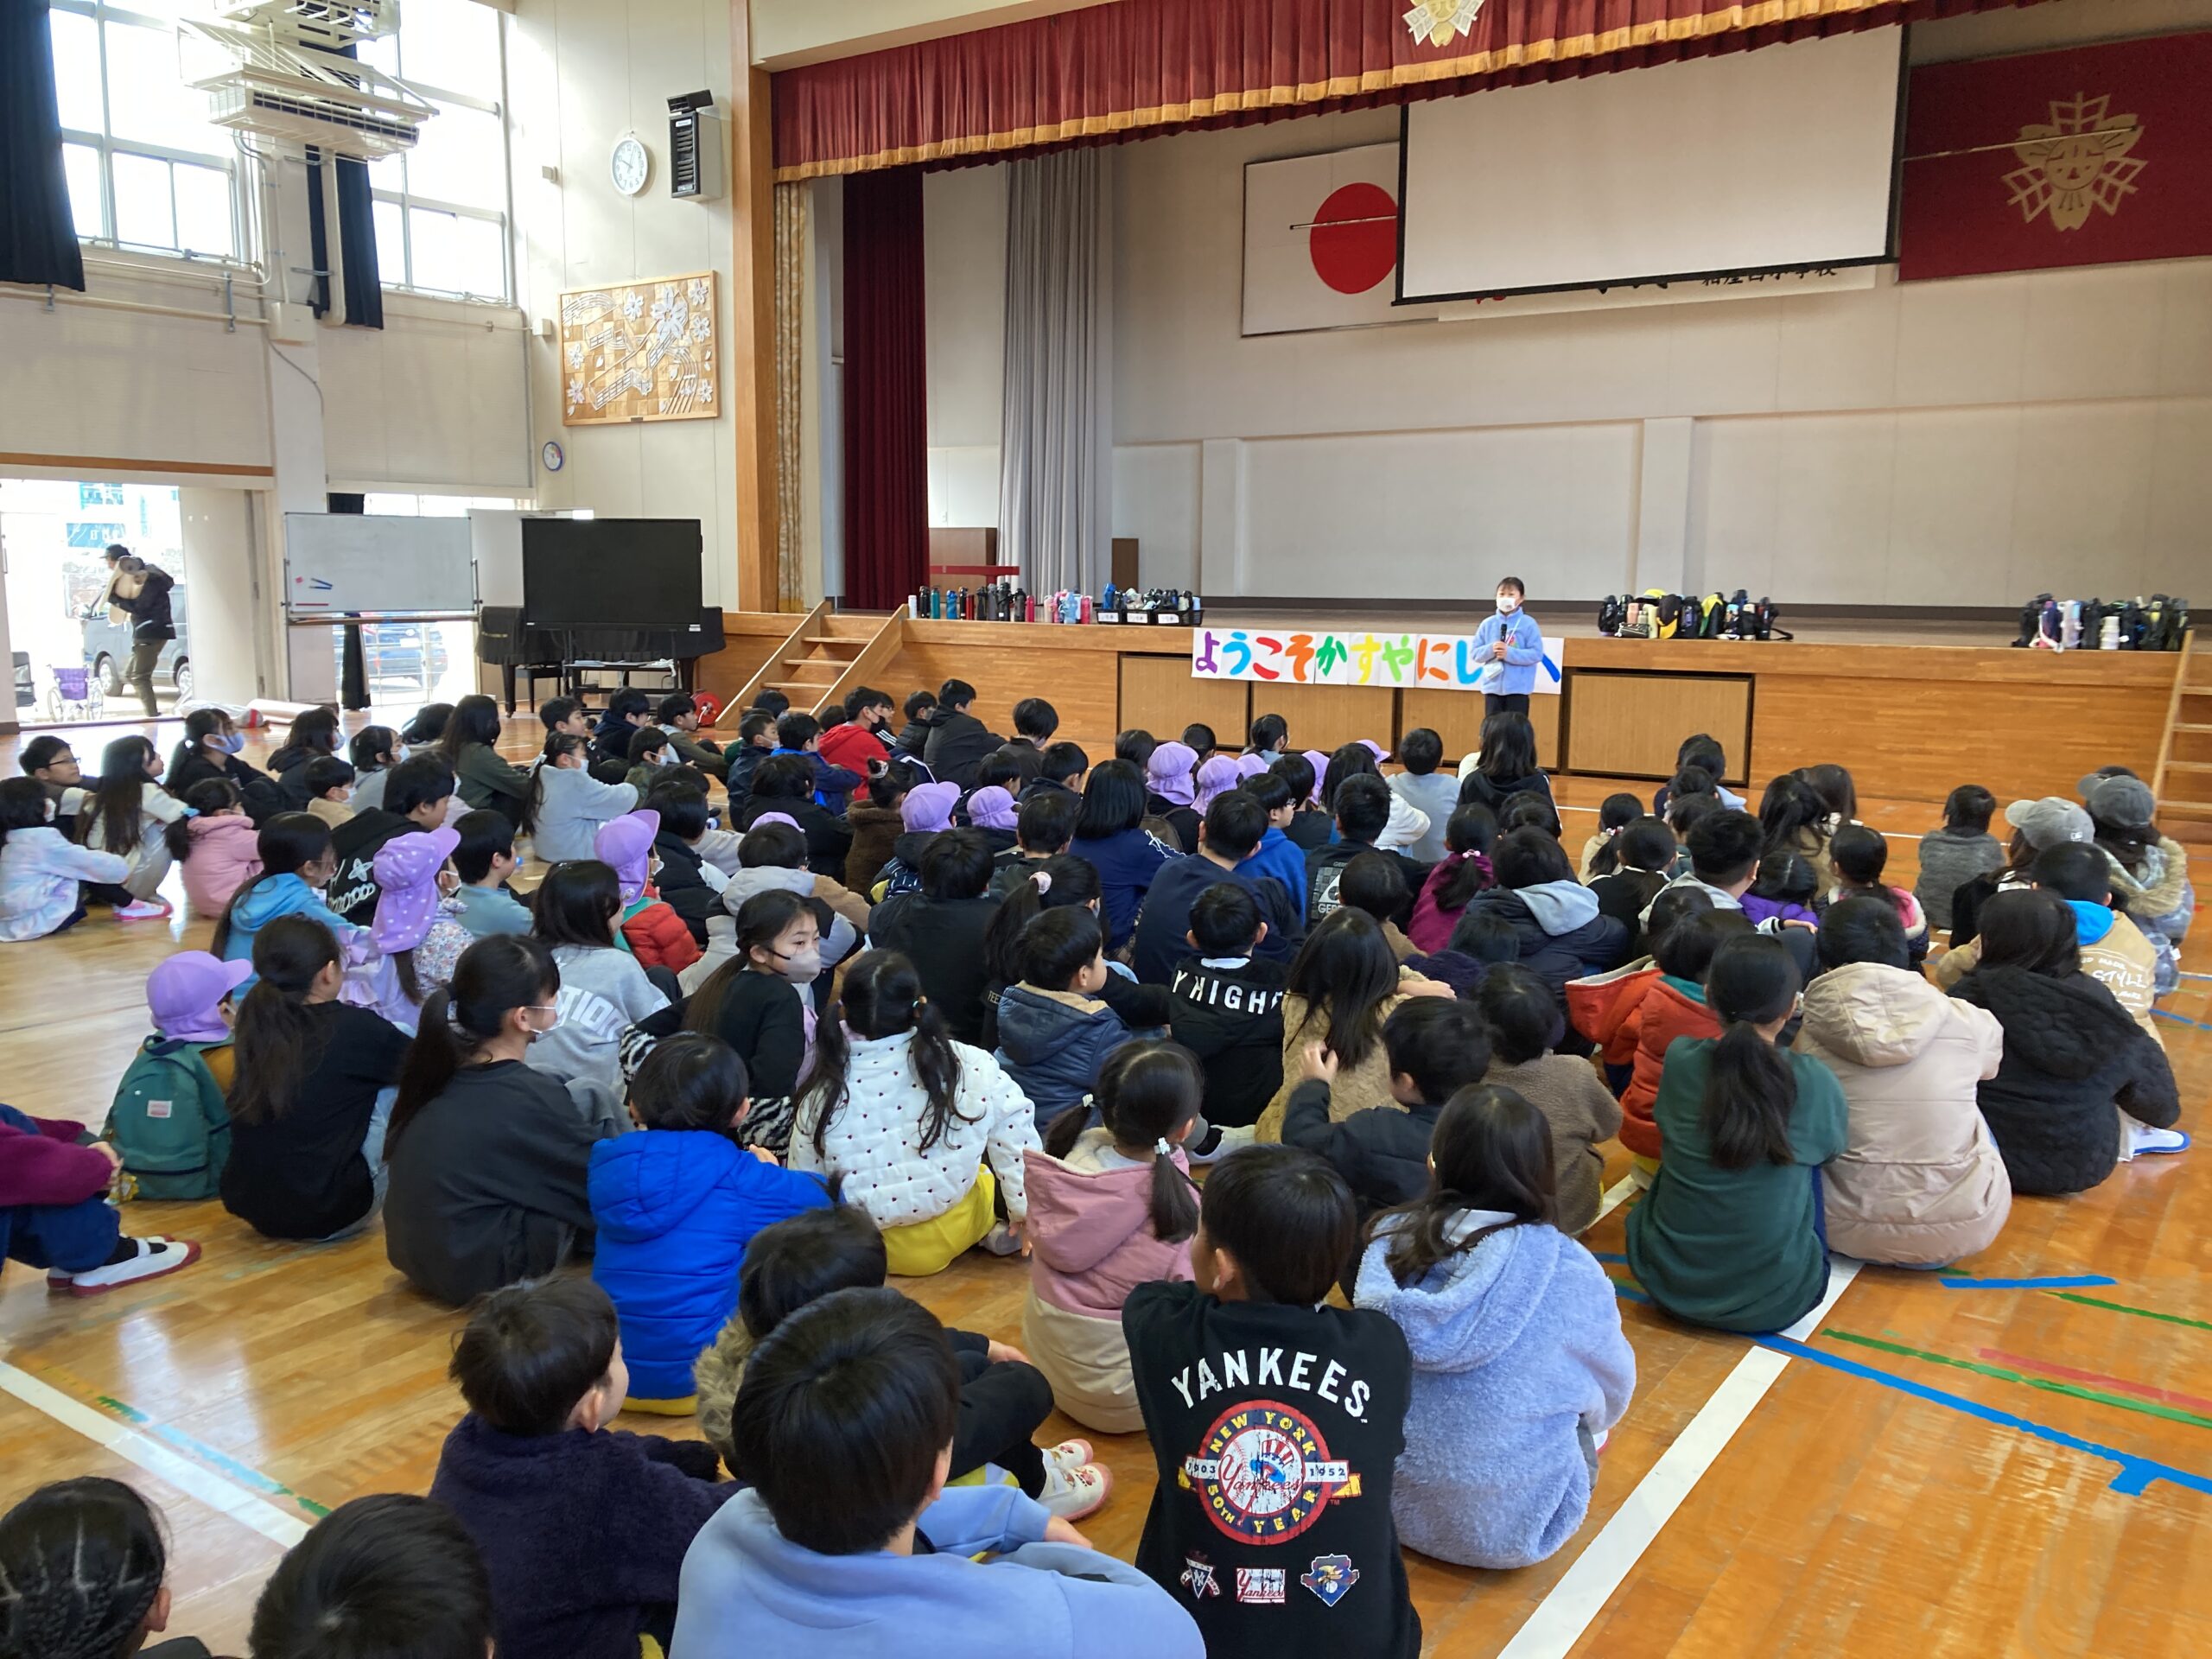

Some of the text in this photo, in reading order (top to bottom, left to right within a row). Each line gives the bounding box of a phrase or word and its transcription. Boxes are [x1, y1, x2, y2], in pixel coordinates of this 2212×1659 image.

[1195, 631, 1560, 683] ようこそかすやにしへ
[1172, 1347, 1370, 1417] YANKEES
[1210, 1411, 1317, 1456] NEW YORK
[1188, 1462, 1217, 1474] 1903
[1219, 1454, 1303, 1496] Yankees
[1309, 1467, 1346, 1477] 1952
[1208, 1484, 1318, 1534] 50TH YEAR
[1236, 1569, 1285, 1601] Yankees
